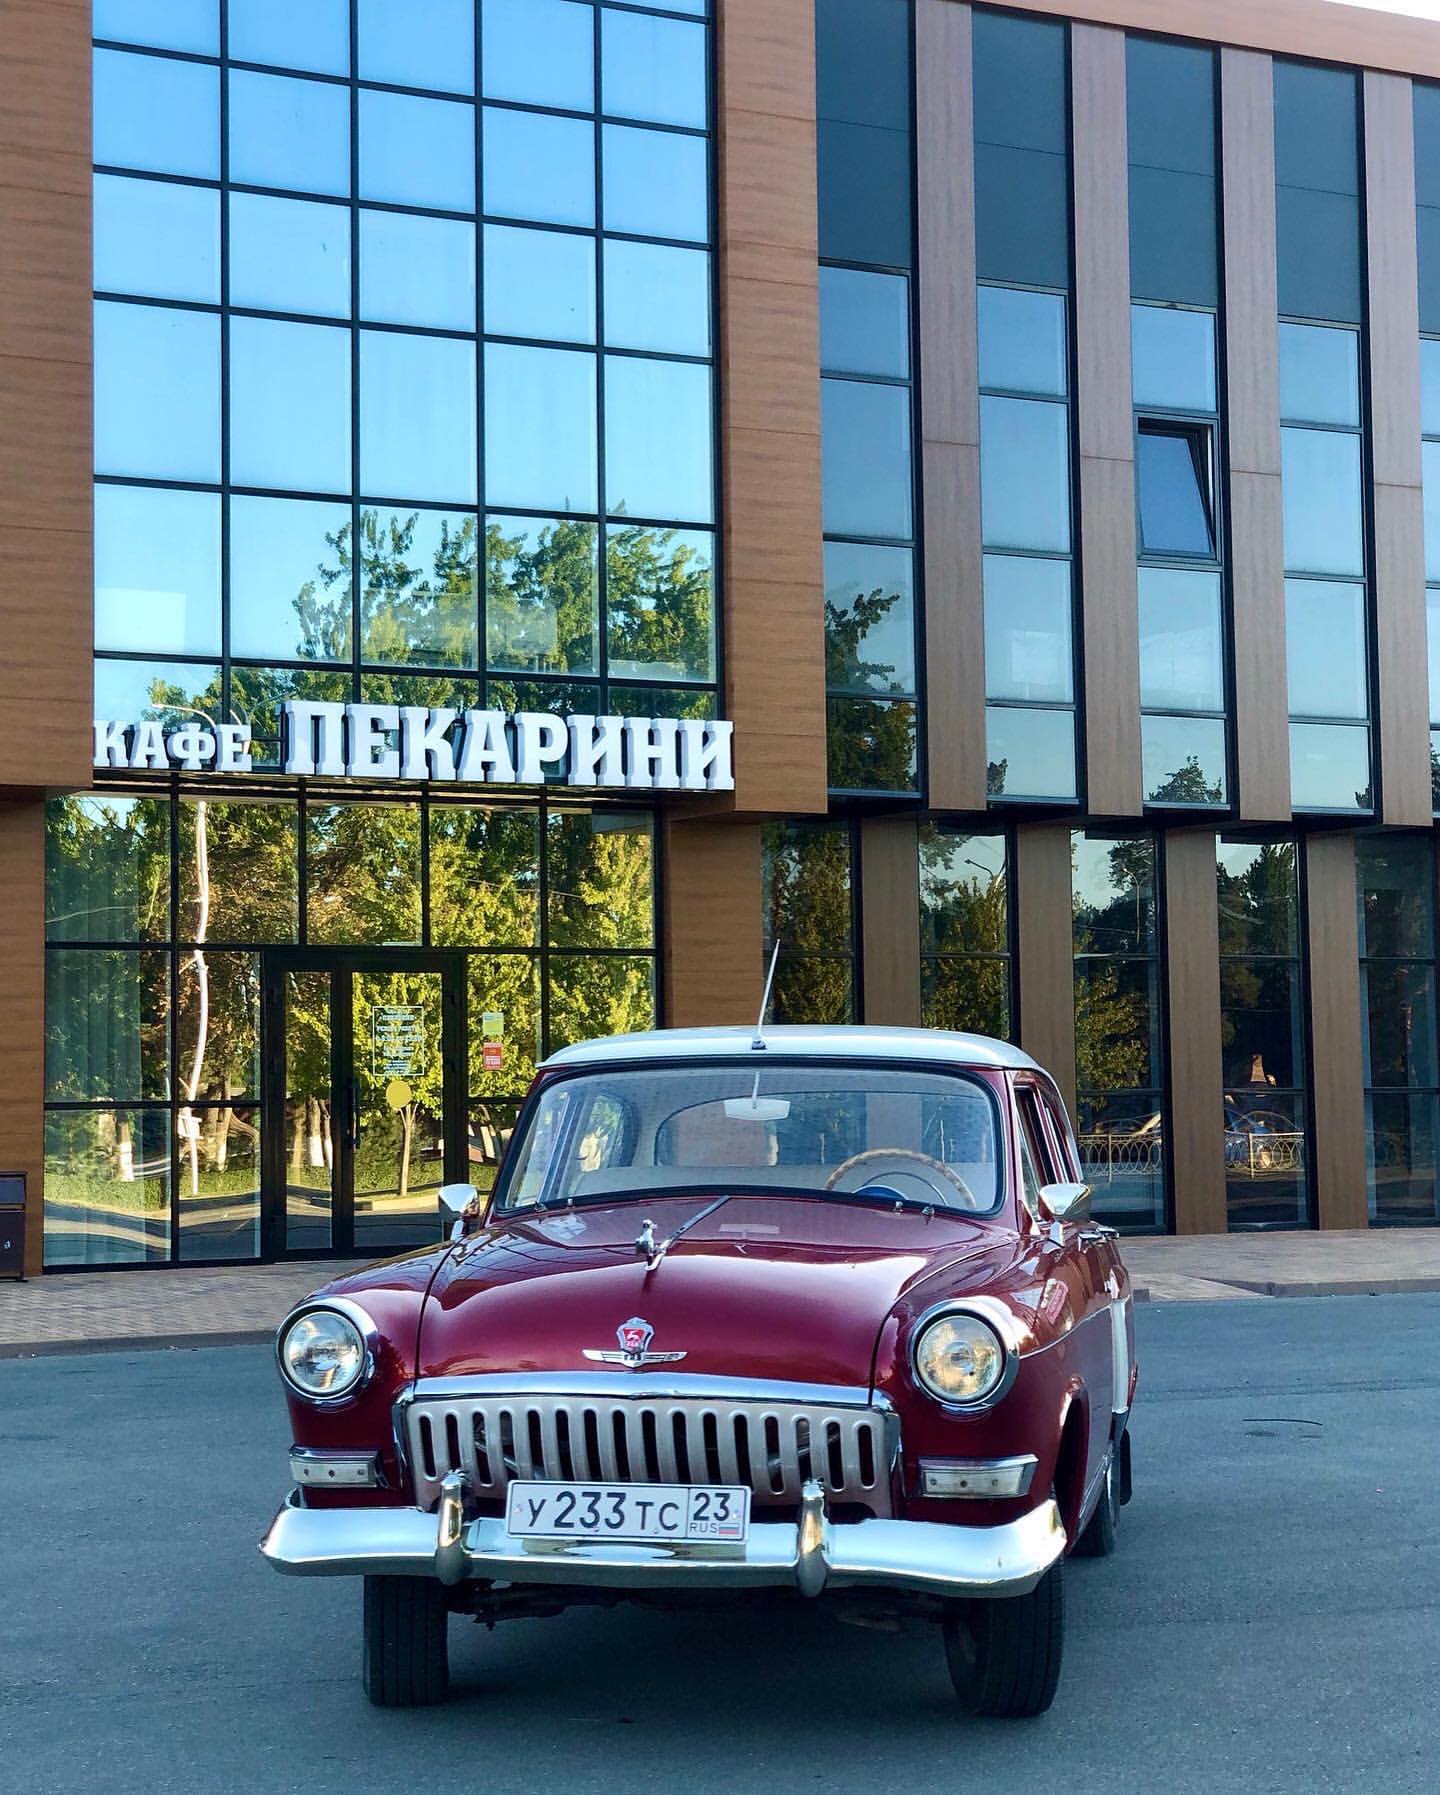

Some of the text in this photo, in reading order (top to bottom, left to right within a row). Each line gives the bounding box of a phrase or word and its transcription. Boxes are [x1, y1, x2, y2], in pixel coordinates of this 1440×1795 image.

[93, 701, 735, 790] КАФЕ ПЕКАРИНИ
[693, 1492, 731, 1522] 23
[689, 1523, 718, 1534] RUS
